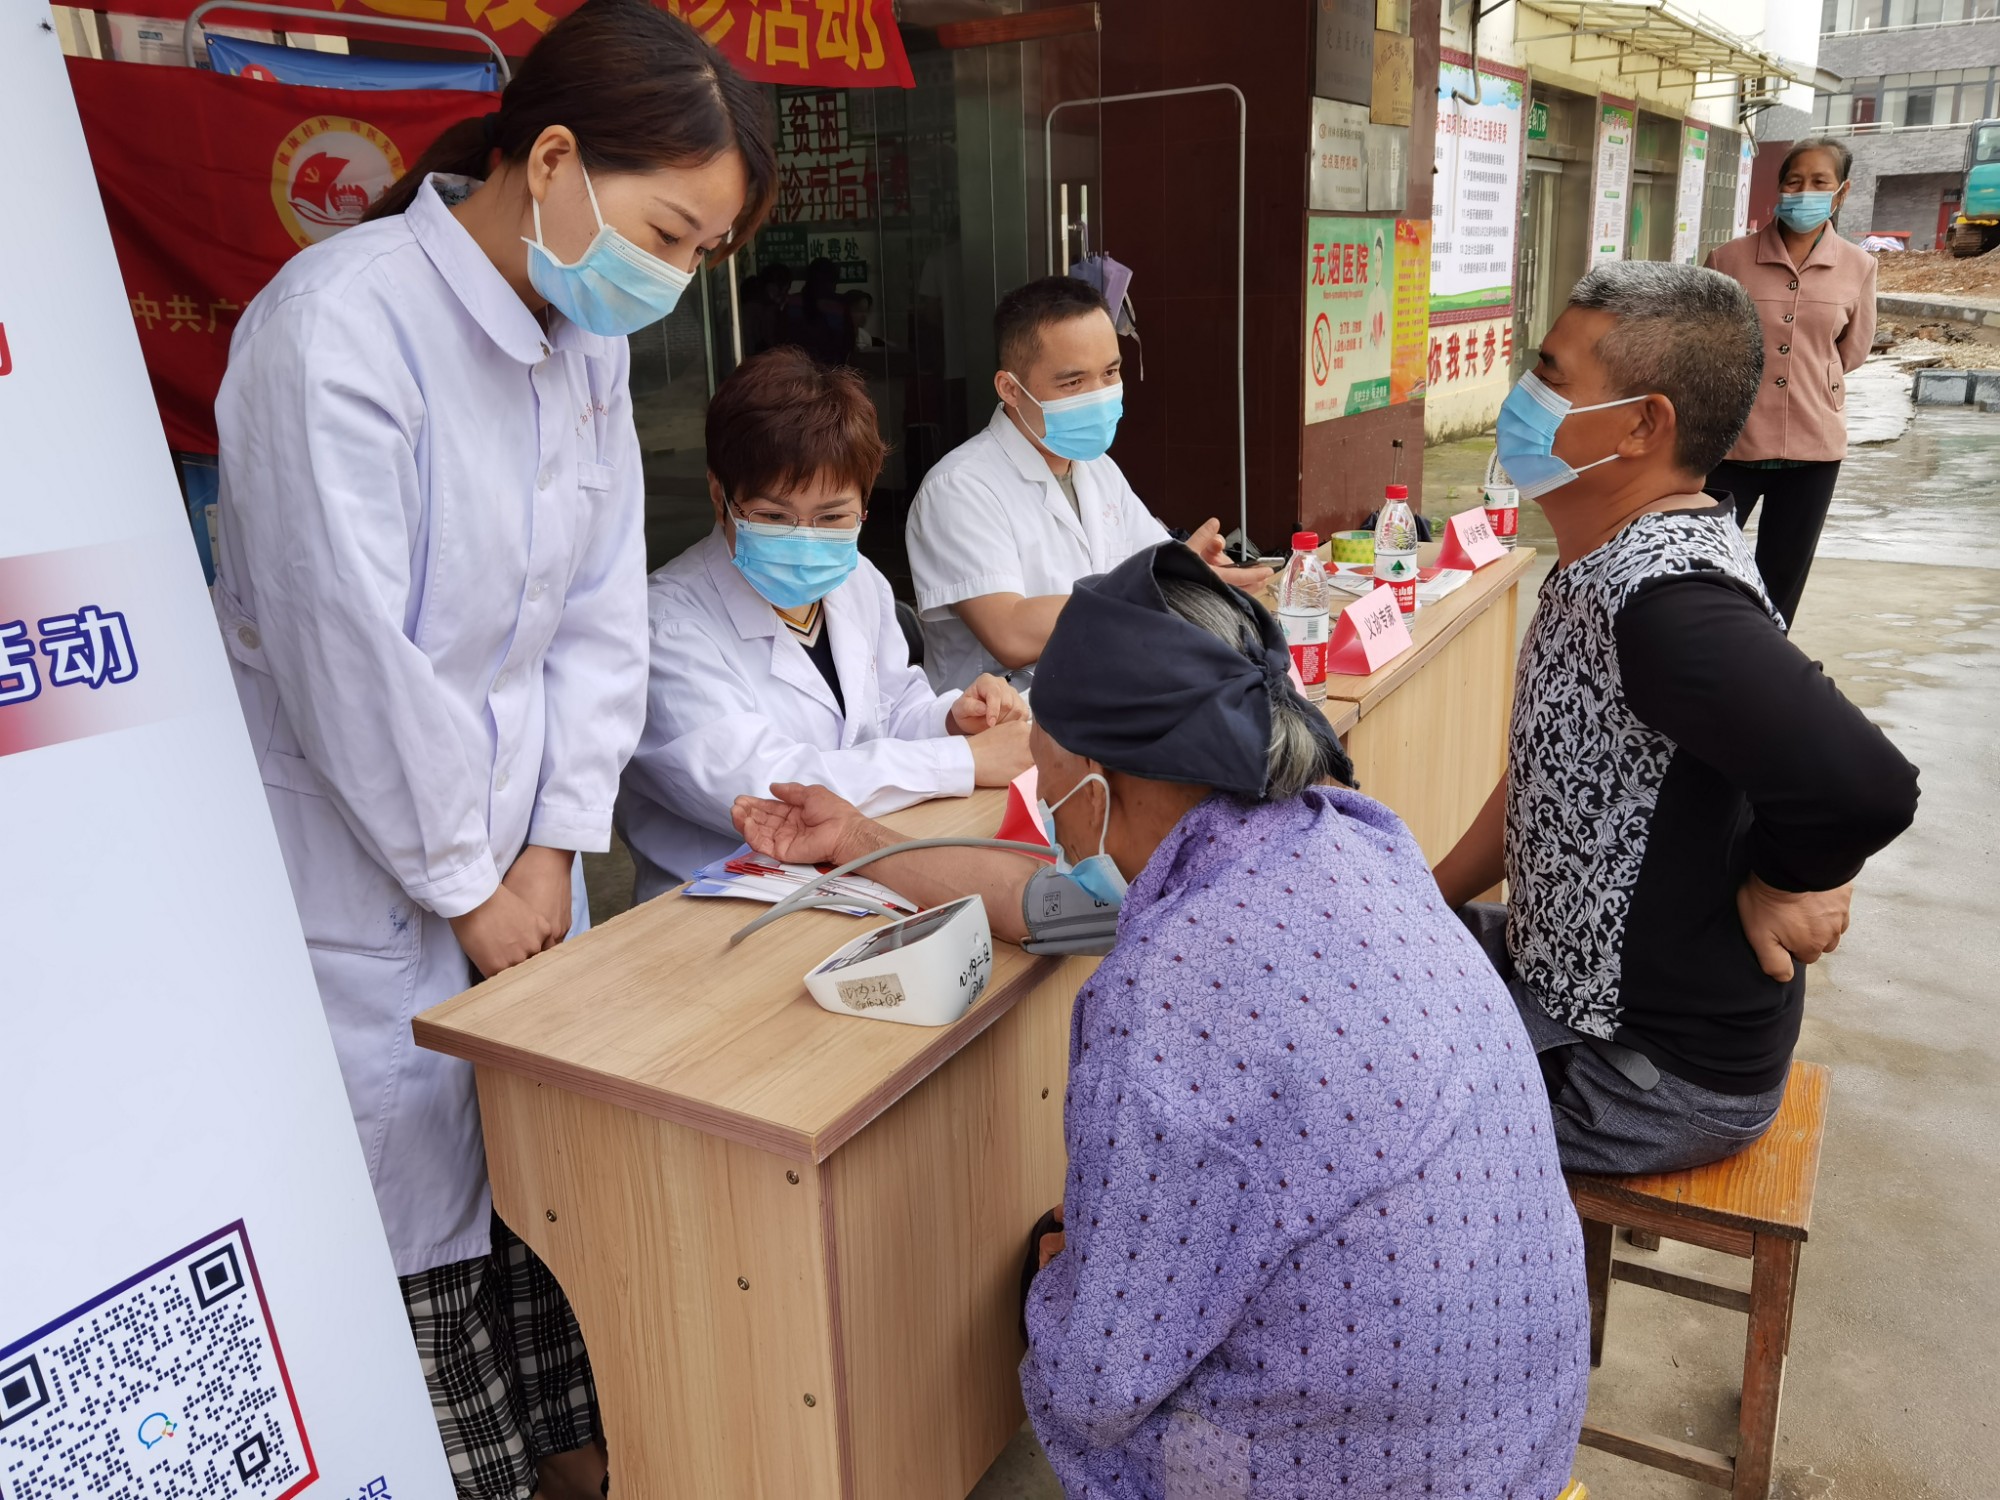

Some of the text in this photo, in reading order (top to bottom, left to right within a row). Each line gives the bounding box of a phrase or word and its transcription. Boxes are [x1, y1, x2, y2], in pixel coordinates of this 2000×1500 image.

[810, 237, 860, 261] 收费处
[1312, 243, 1369, 286] 无烟医院
[131, 292, 249, 334] 中共广
[1428, 321, 1512, 387] 你我共参与
[1364, 604, 1396, 640] 义诊专家
